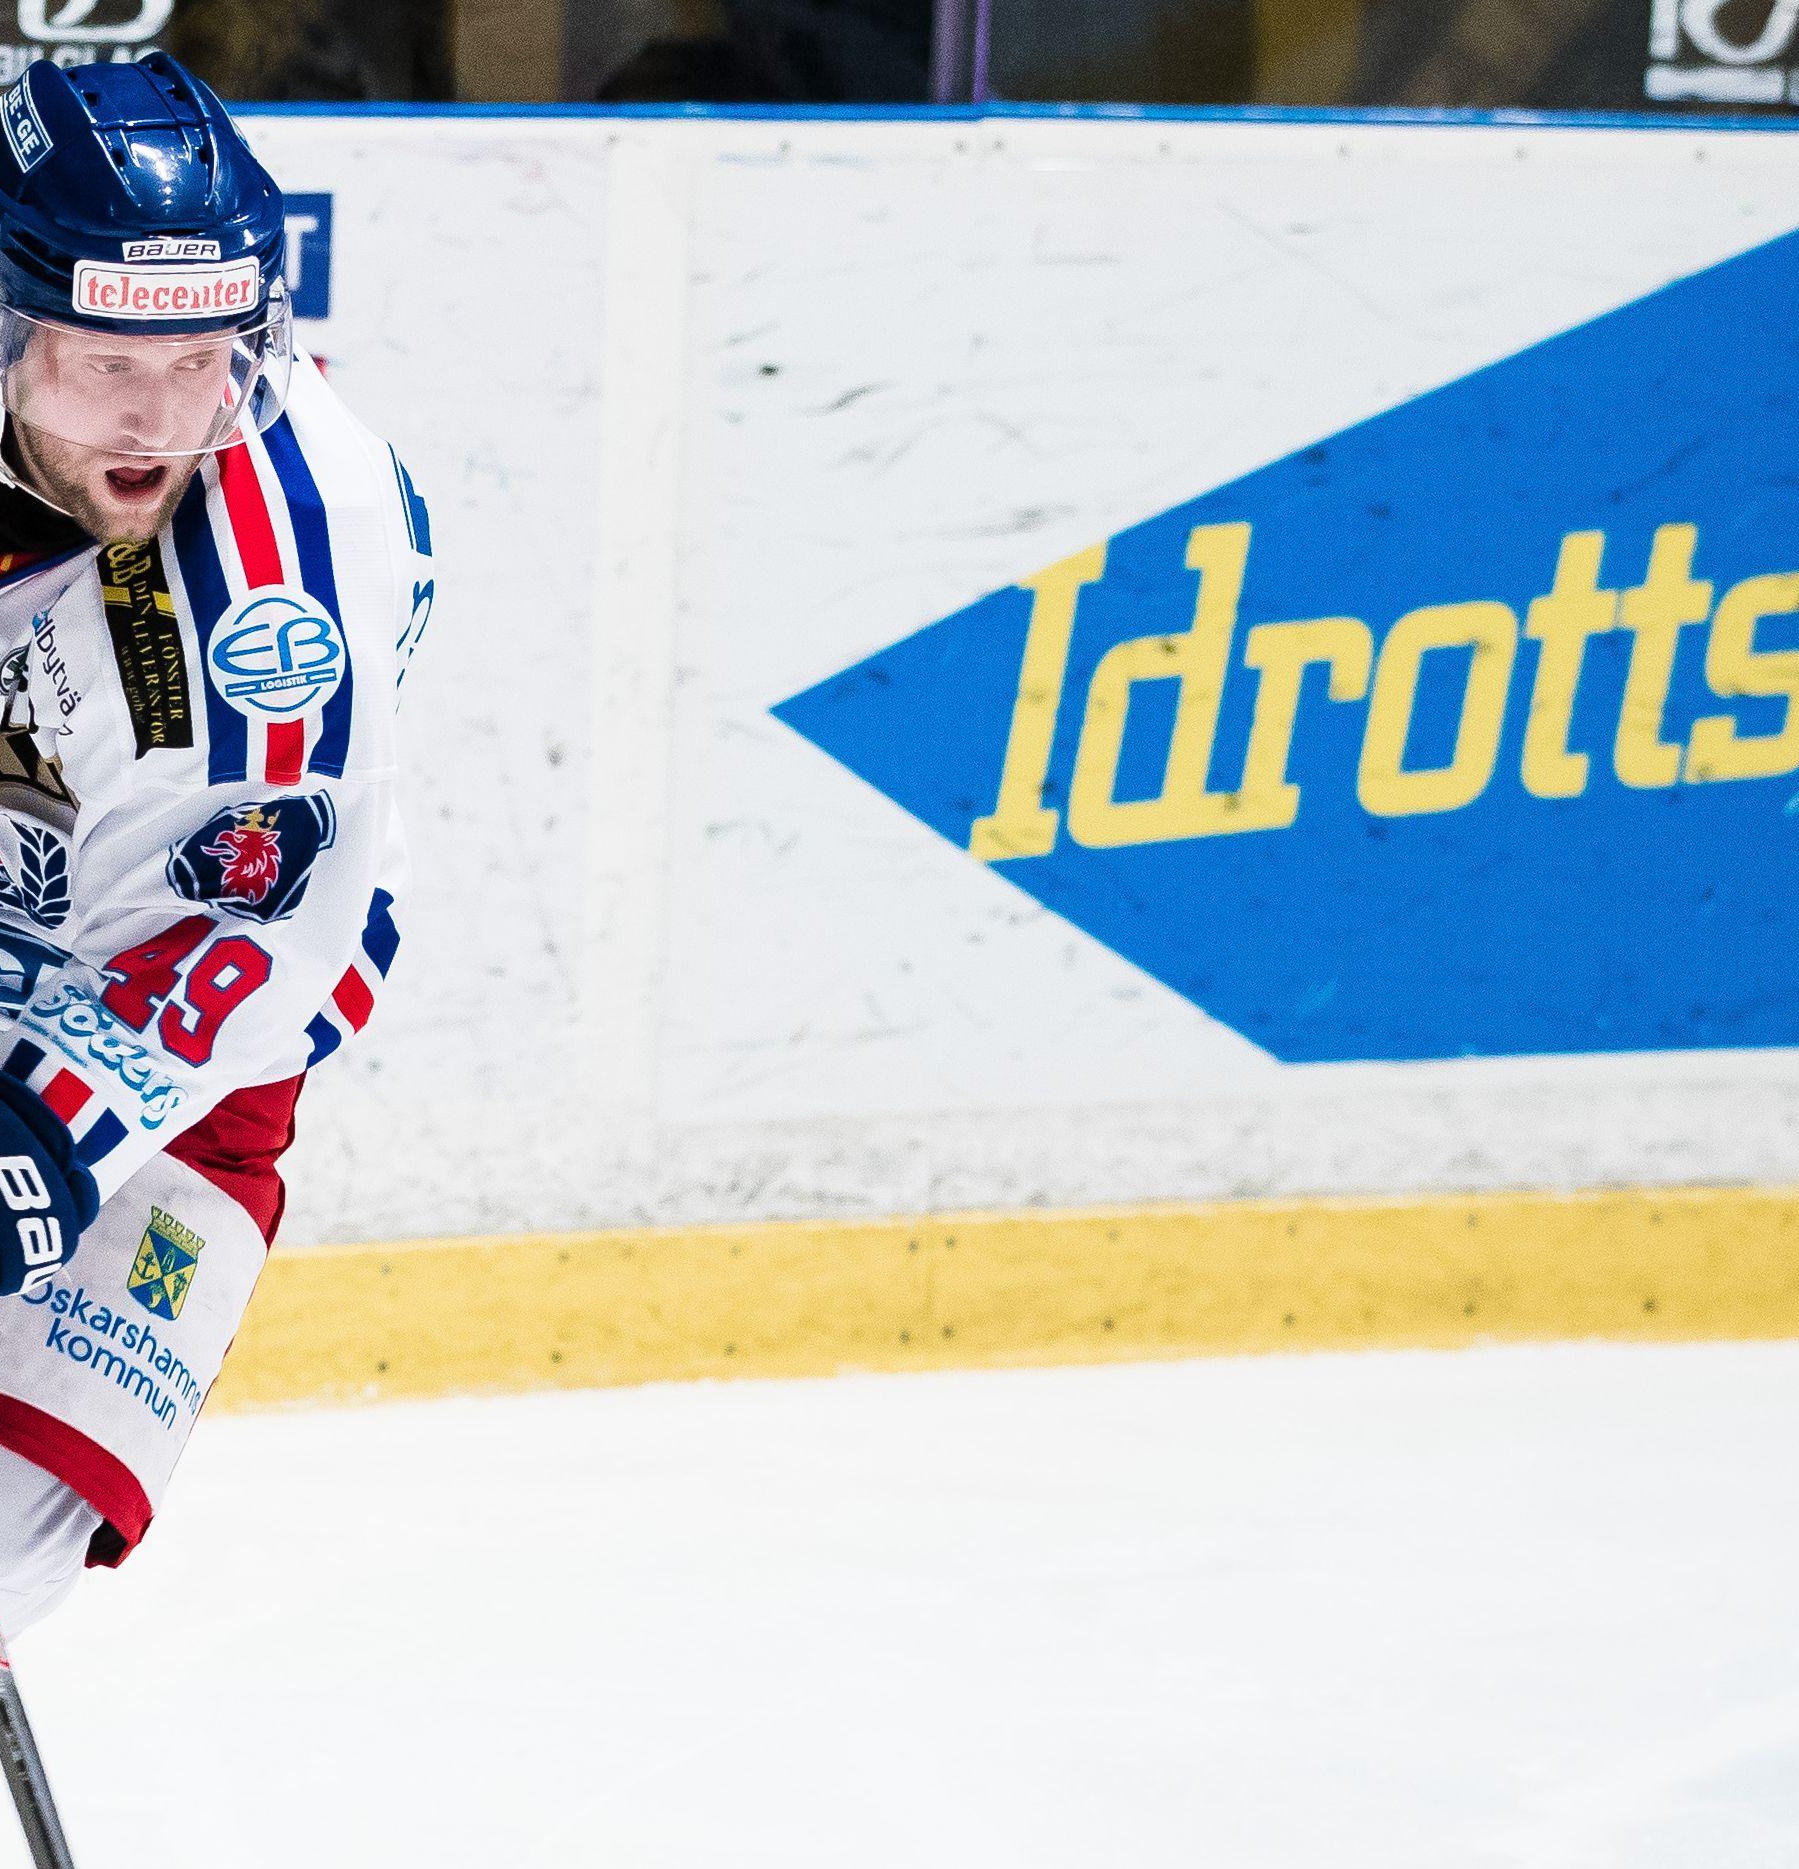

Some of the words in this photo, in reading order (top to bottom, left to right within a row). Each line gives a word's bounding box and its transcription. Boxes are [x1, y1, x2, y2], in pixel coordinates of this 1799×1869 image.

[127, 243, 218, 258] BAUER
[87, 276, 251, 311] telecenter
[212, 617, 340, 676] EB
[260, 675, 308, 691] LOGISTIK
[969, 523, 1799, 862] Idrotts
[100, 911, 273, 1068] 49
[45, 1317, 178, 1431] kommun
